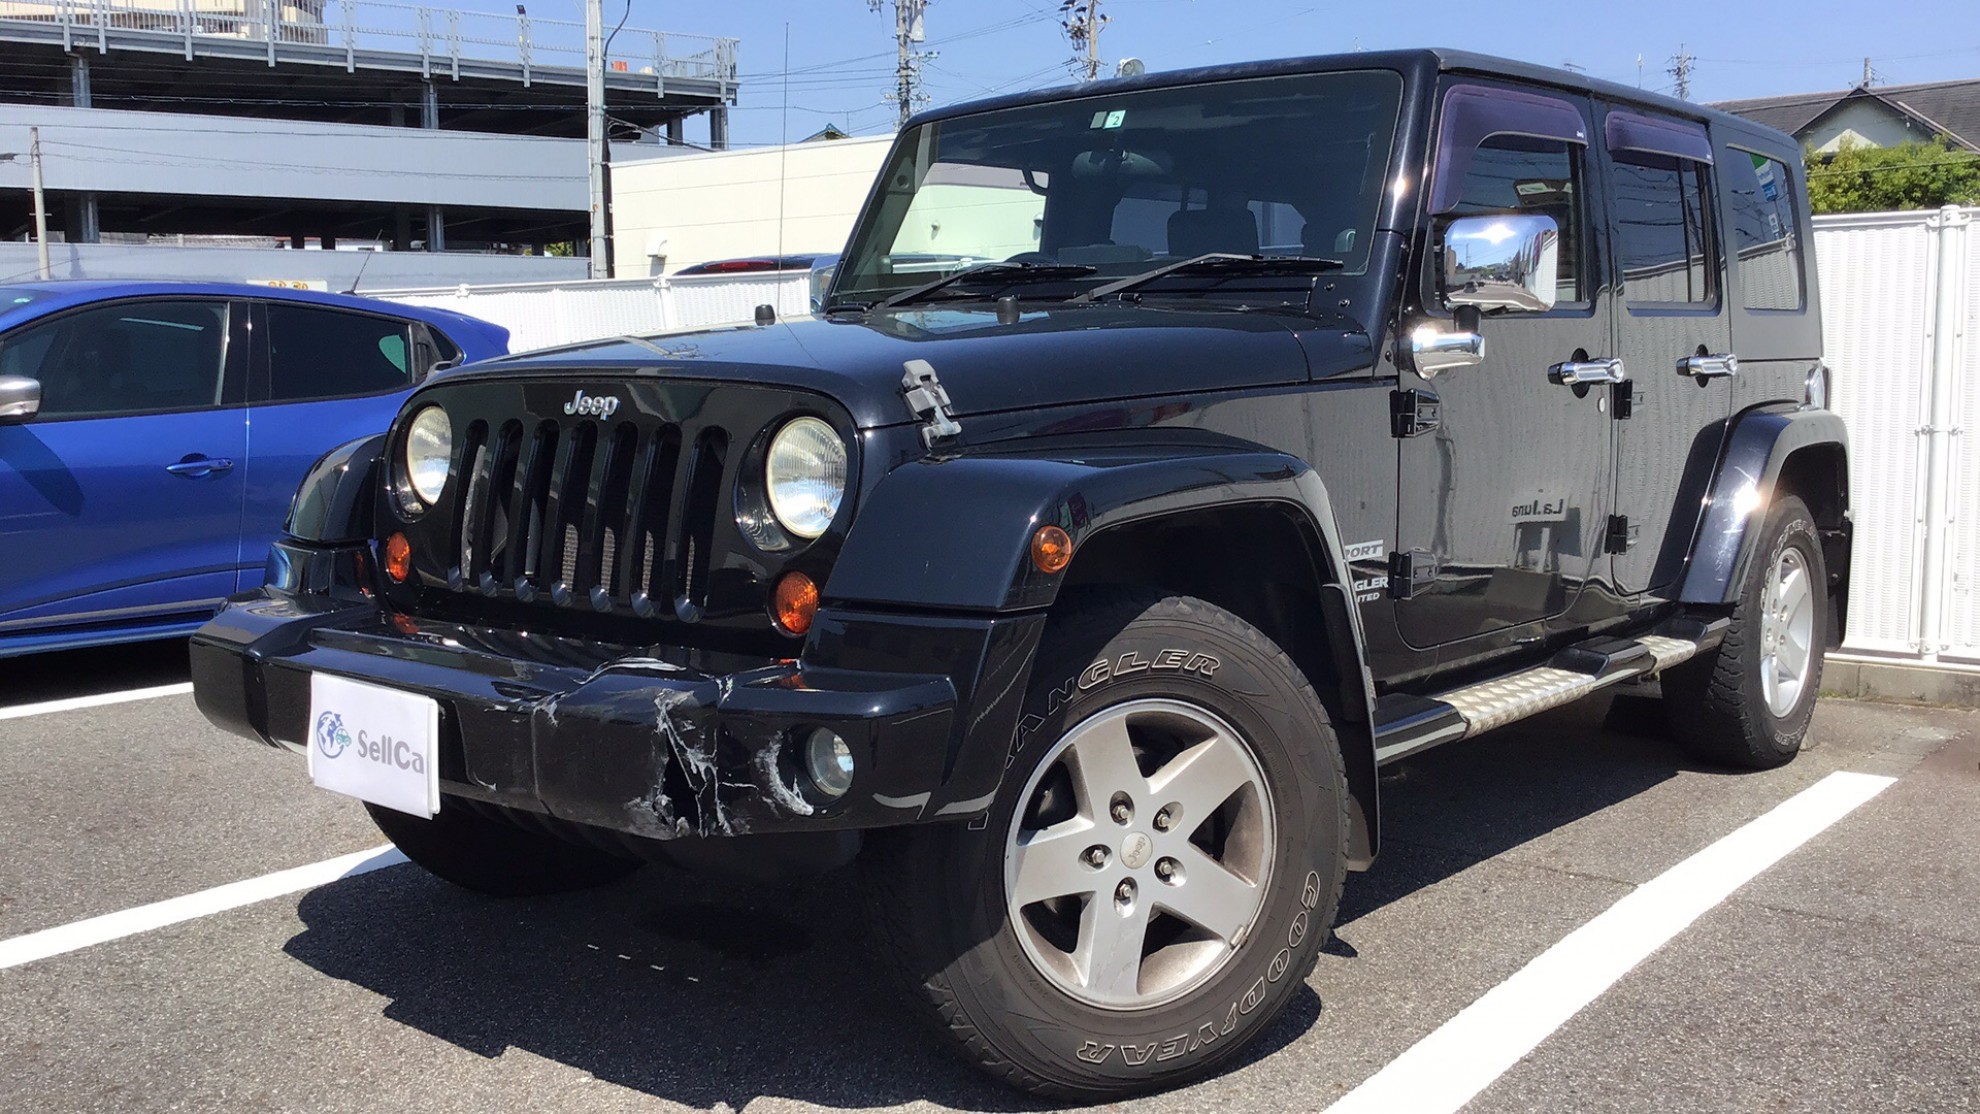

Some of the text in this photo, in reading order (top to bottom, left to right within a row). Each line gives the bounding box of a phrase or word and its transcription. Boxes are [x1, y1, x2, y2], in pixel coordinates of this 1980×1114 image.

[563, 389, 620, 421] Jeep
[1005, 648, 1222, 770] ANGLER
[357, 729, 425, 775] SellCa
[1075, 869, 1322, 1066] GOODYEAR
